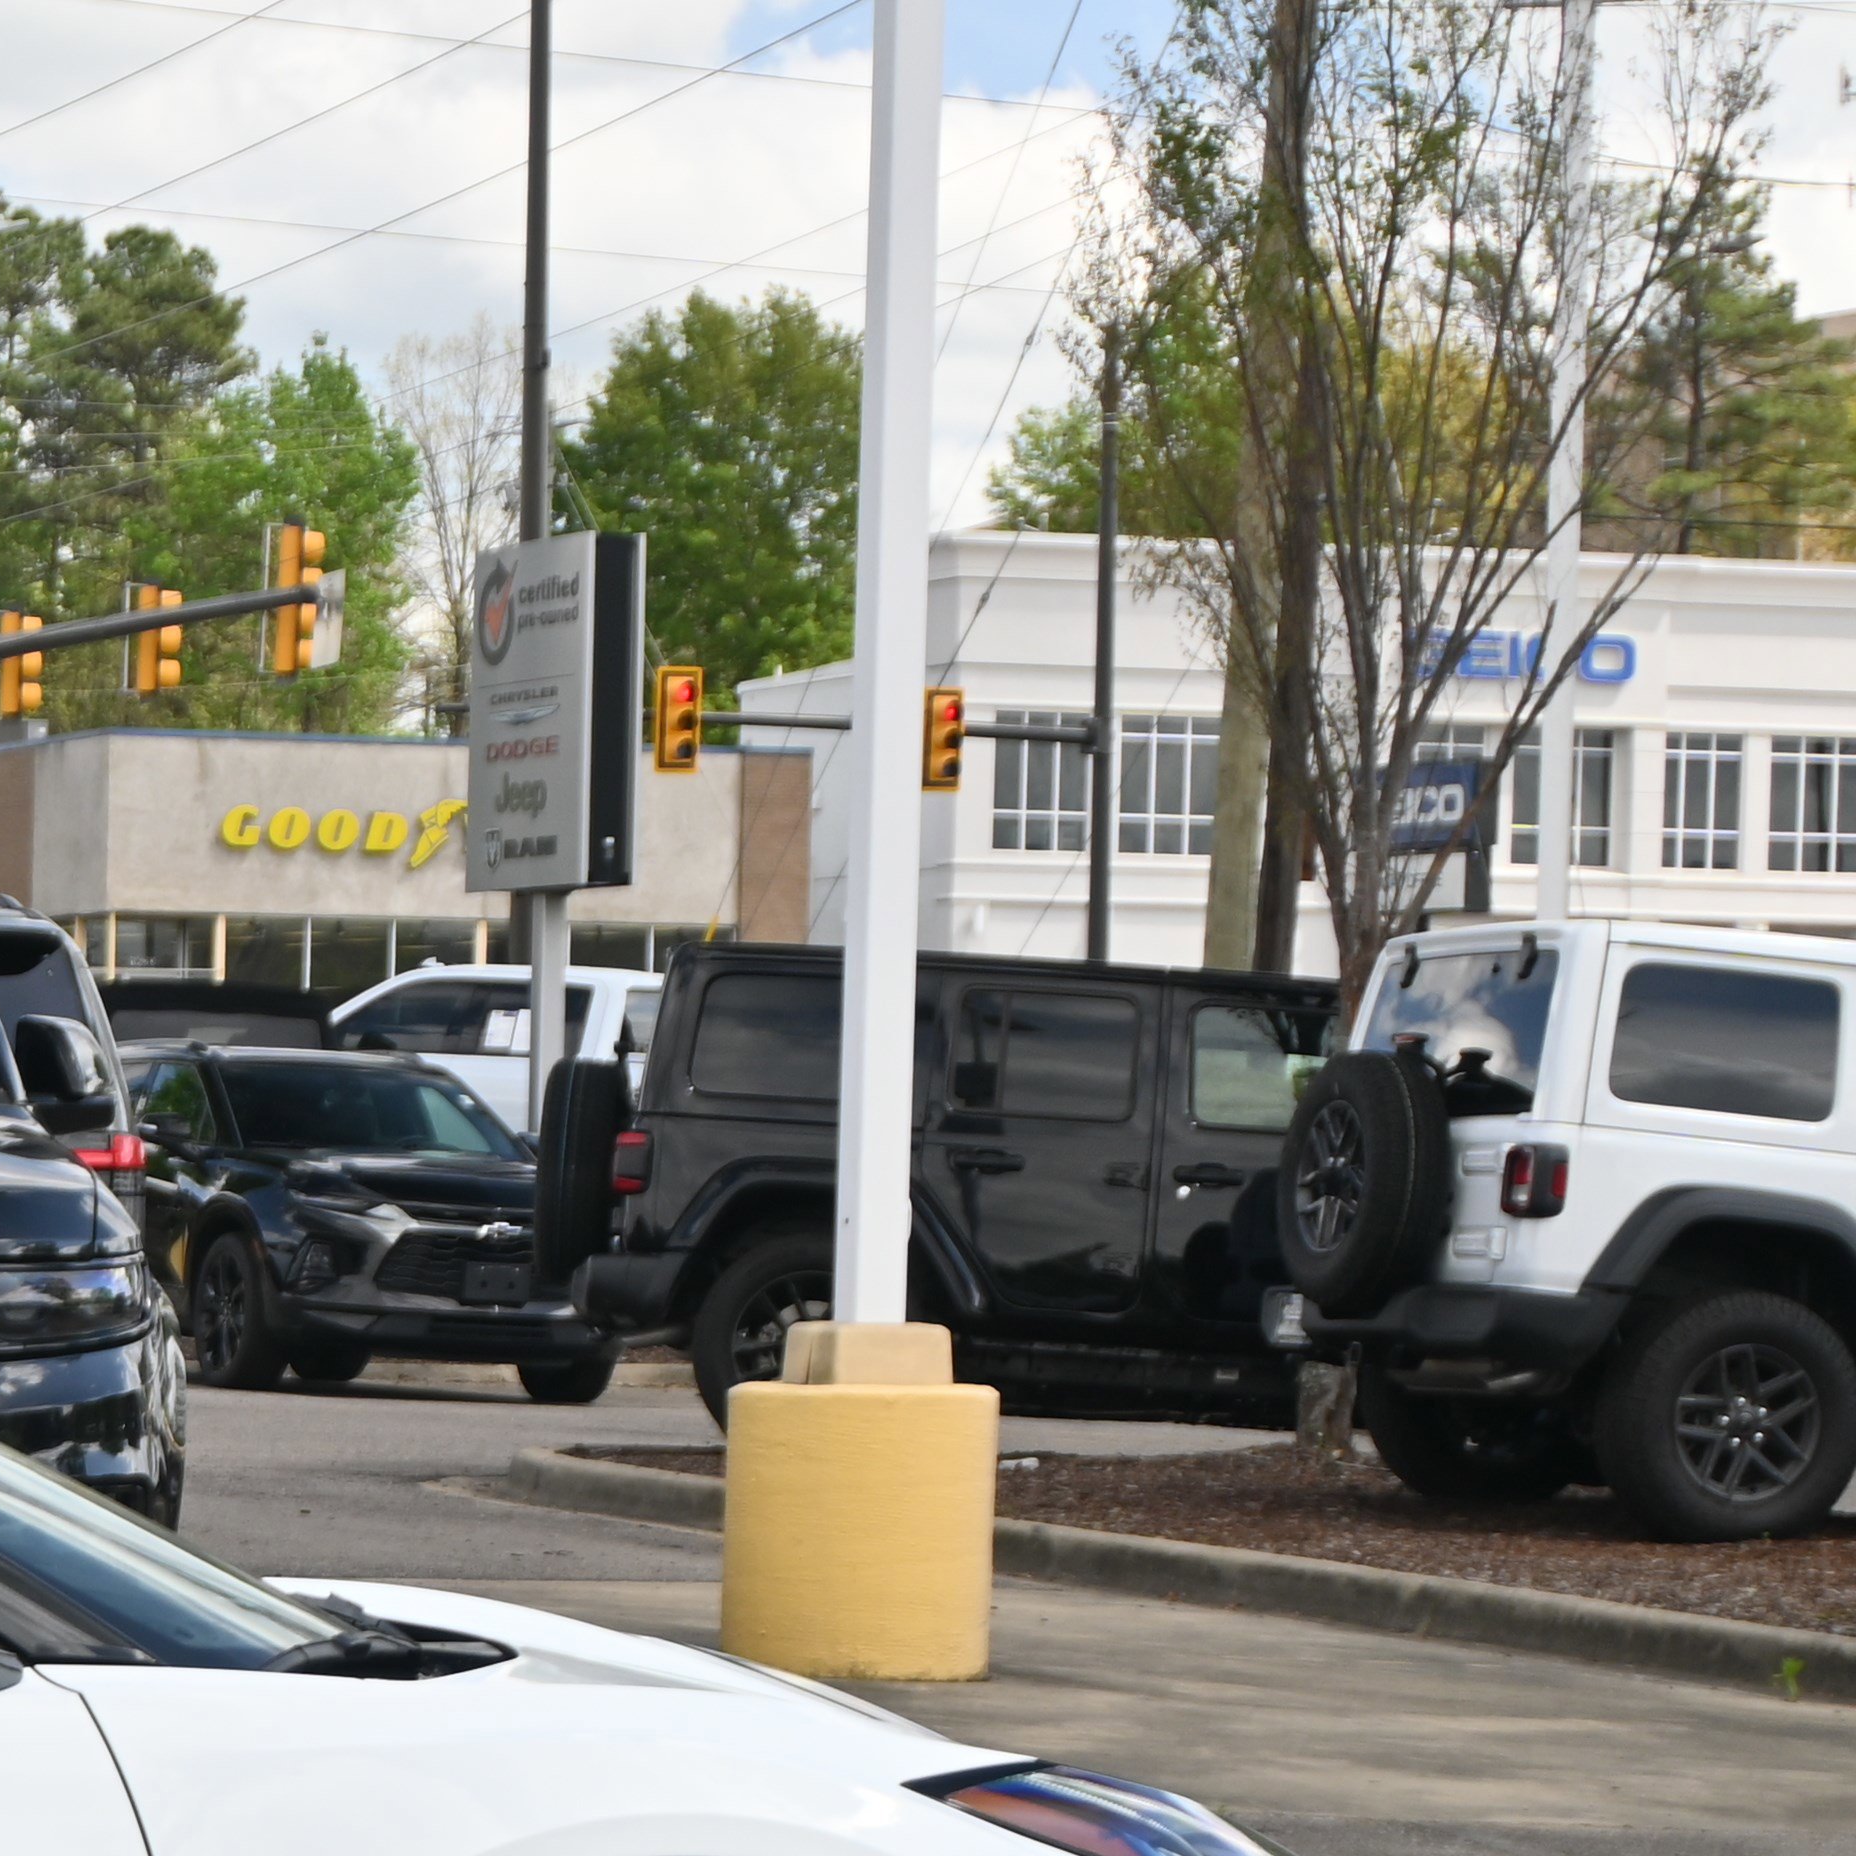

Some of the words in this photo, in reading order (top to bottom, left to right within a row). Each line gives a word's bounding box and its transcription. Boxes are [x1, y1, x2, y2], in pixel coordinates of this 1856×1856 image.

[518, 571, 579, 604] certified
[517, 601, 579, 633] pre-owned
[491, 687, 559, 705] CHRYSLER
[487, 735, 560, 763] DODGE
[495, 771, 548, 819] Jeep
[222, 803, 409, 851] GOOD
[503, 835, 558, 859] RAM
